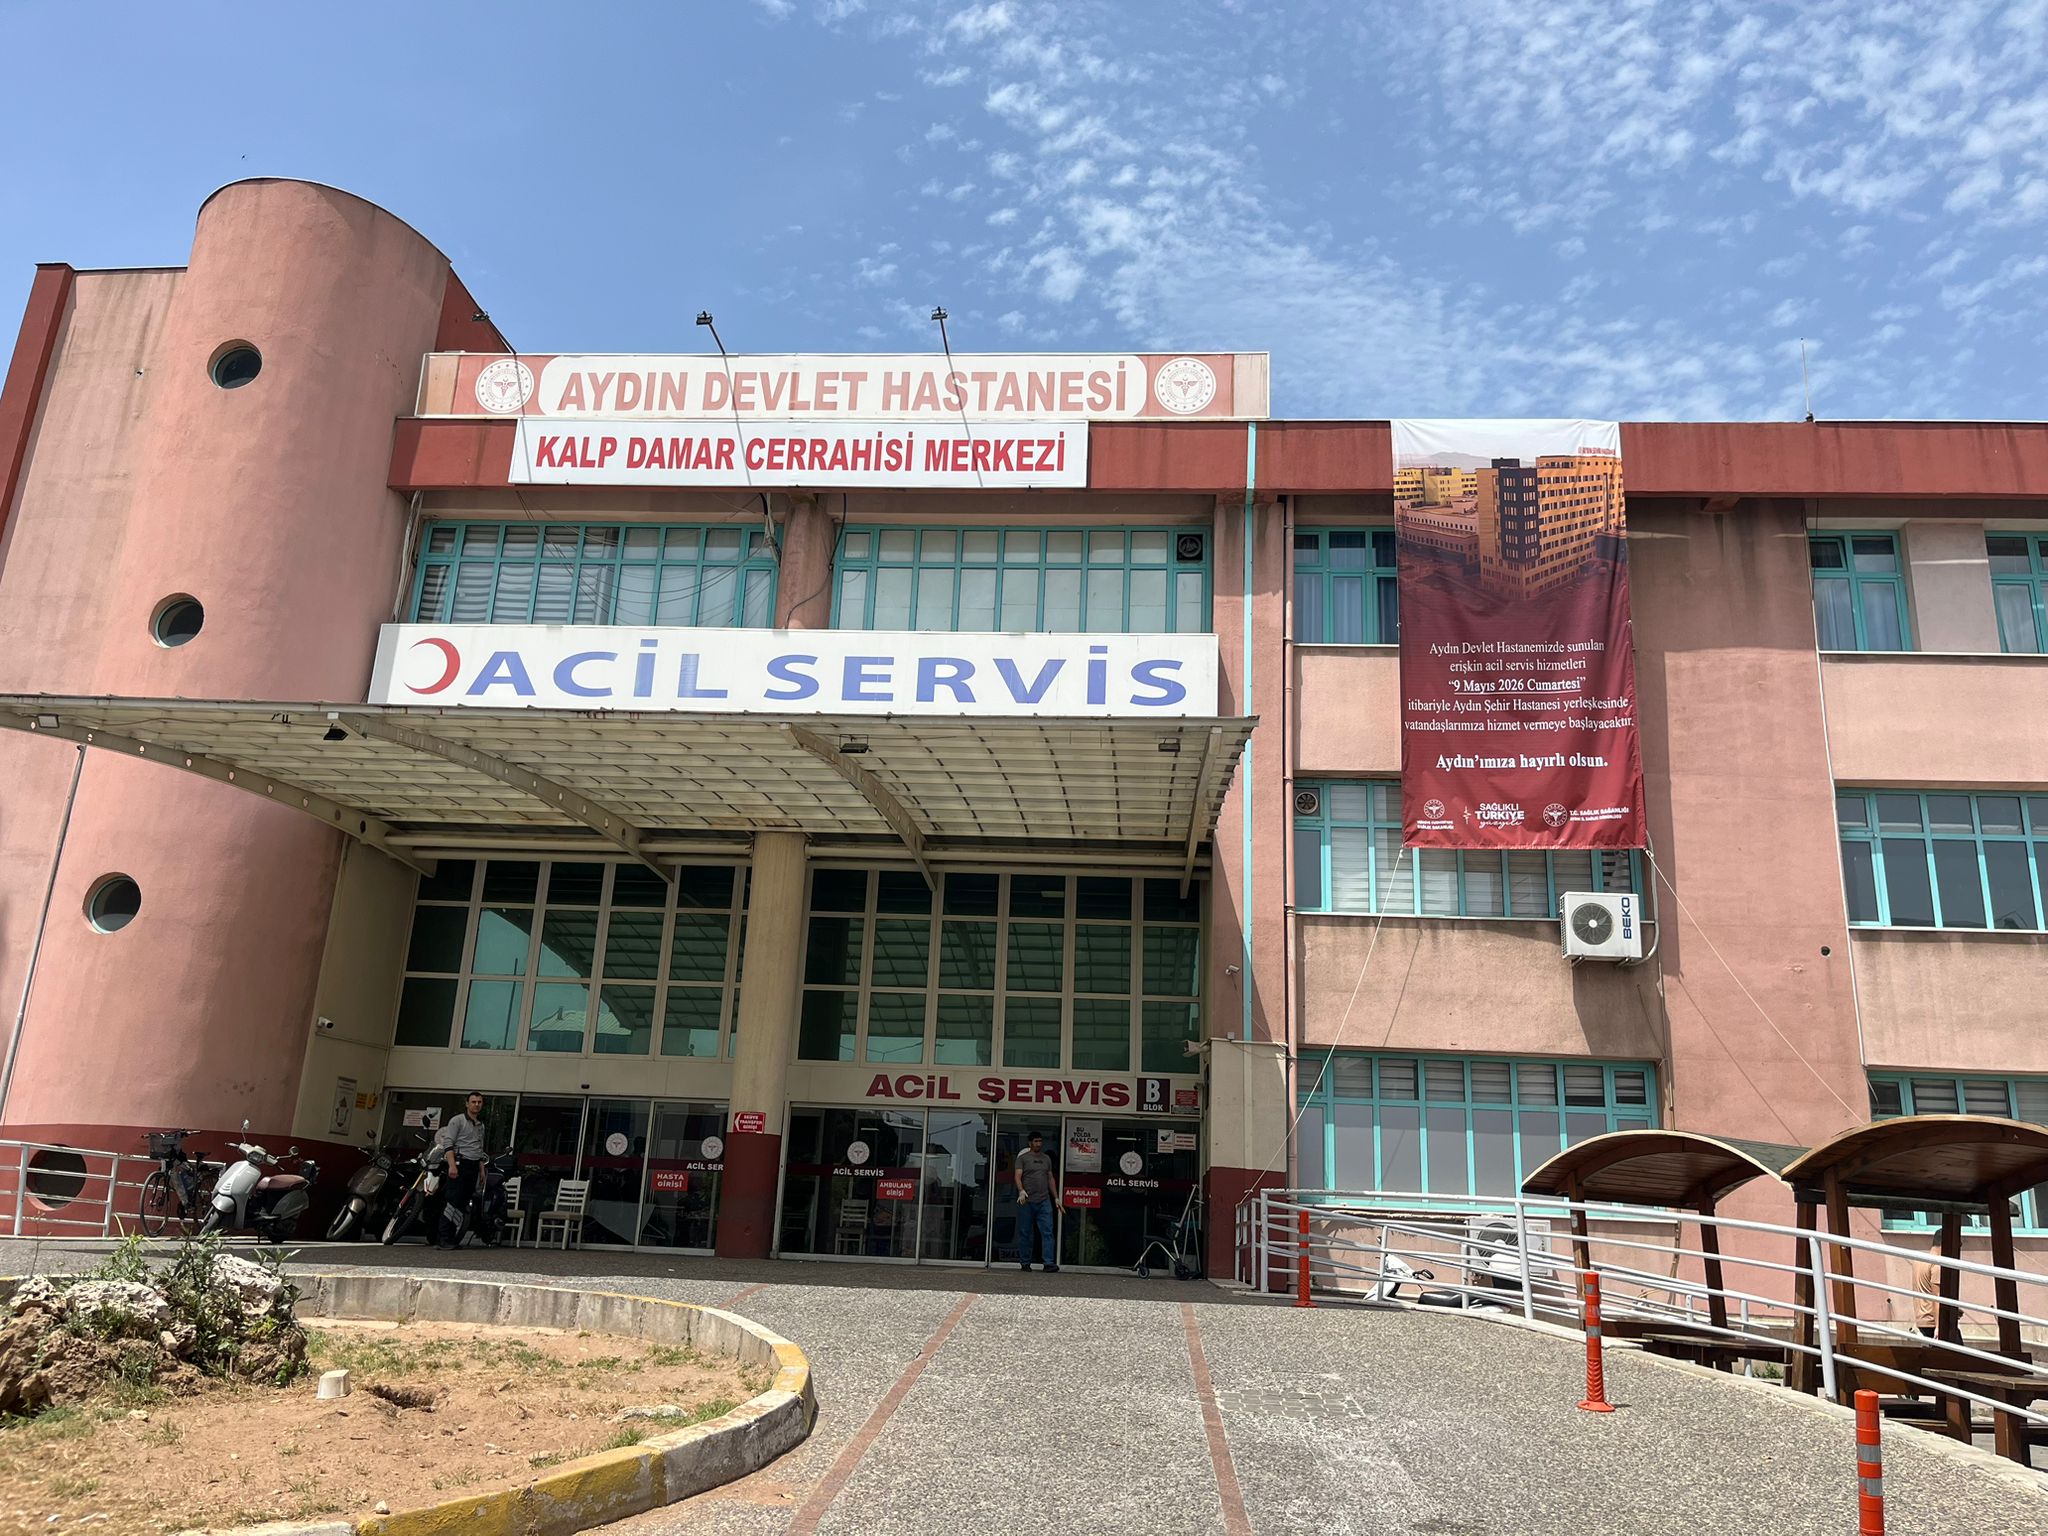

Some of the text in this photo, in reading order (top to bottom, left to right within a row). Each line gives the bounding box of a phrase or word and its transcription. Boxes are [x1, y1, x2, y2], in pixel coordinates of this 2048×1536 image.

[557, 371, 688, 411] AYDIN
[702, 371, 867, 411] DEVLET
[882, 360, 1126, 412] HASTANESİ
[536, 431, 1065, 472] KALP DAMAR CERRAHİSİ MERKEZİ
[1430, 639, 1605, 657] Aydın Devlet Hastanemizde sunulan
[465, 638, 1187, 706] ACİL SERVİS
[1450, 657, 1586, 674] erişkin acil servis hizmetleri
[1463, 680, 1496, 694] Mayıs
[1498, 679, 1524, 691] 2026
[1408, 696, 1629, 714] itibariyle Aydın Şehir Hastanesi yerleşkesinde
[1404, 716, 1635, 733] vatandaşlarımıza hizmet vermeye başlayacaktır.
[1520, 752, 1565, 771] hayırlı
[1569, 752, 1609, 767] olsun.
[1479, 802, 1519, 811] SAĞLIKLI
[1621, 896, 1632, 939] BEKO
[1146, 1079, 1161, 1103] B
[1143, 1103, 1164, 1112] BLOK
[687, 1162, 724, 1171] ACİL SER
[833, 1167, 884, 1177] ACİL SERVİS
[657, 1180, 682, 1188] GİRİŞİ
[879, 1181, 912, 1189] AMBULANS
[1107, 1178, 1159, 1188] ACİL SERVİS
[886, 1189, 904, 1197] GİRİŞİ
[1066, 1189, 1099, 1197] AMBULANS
